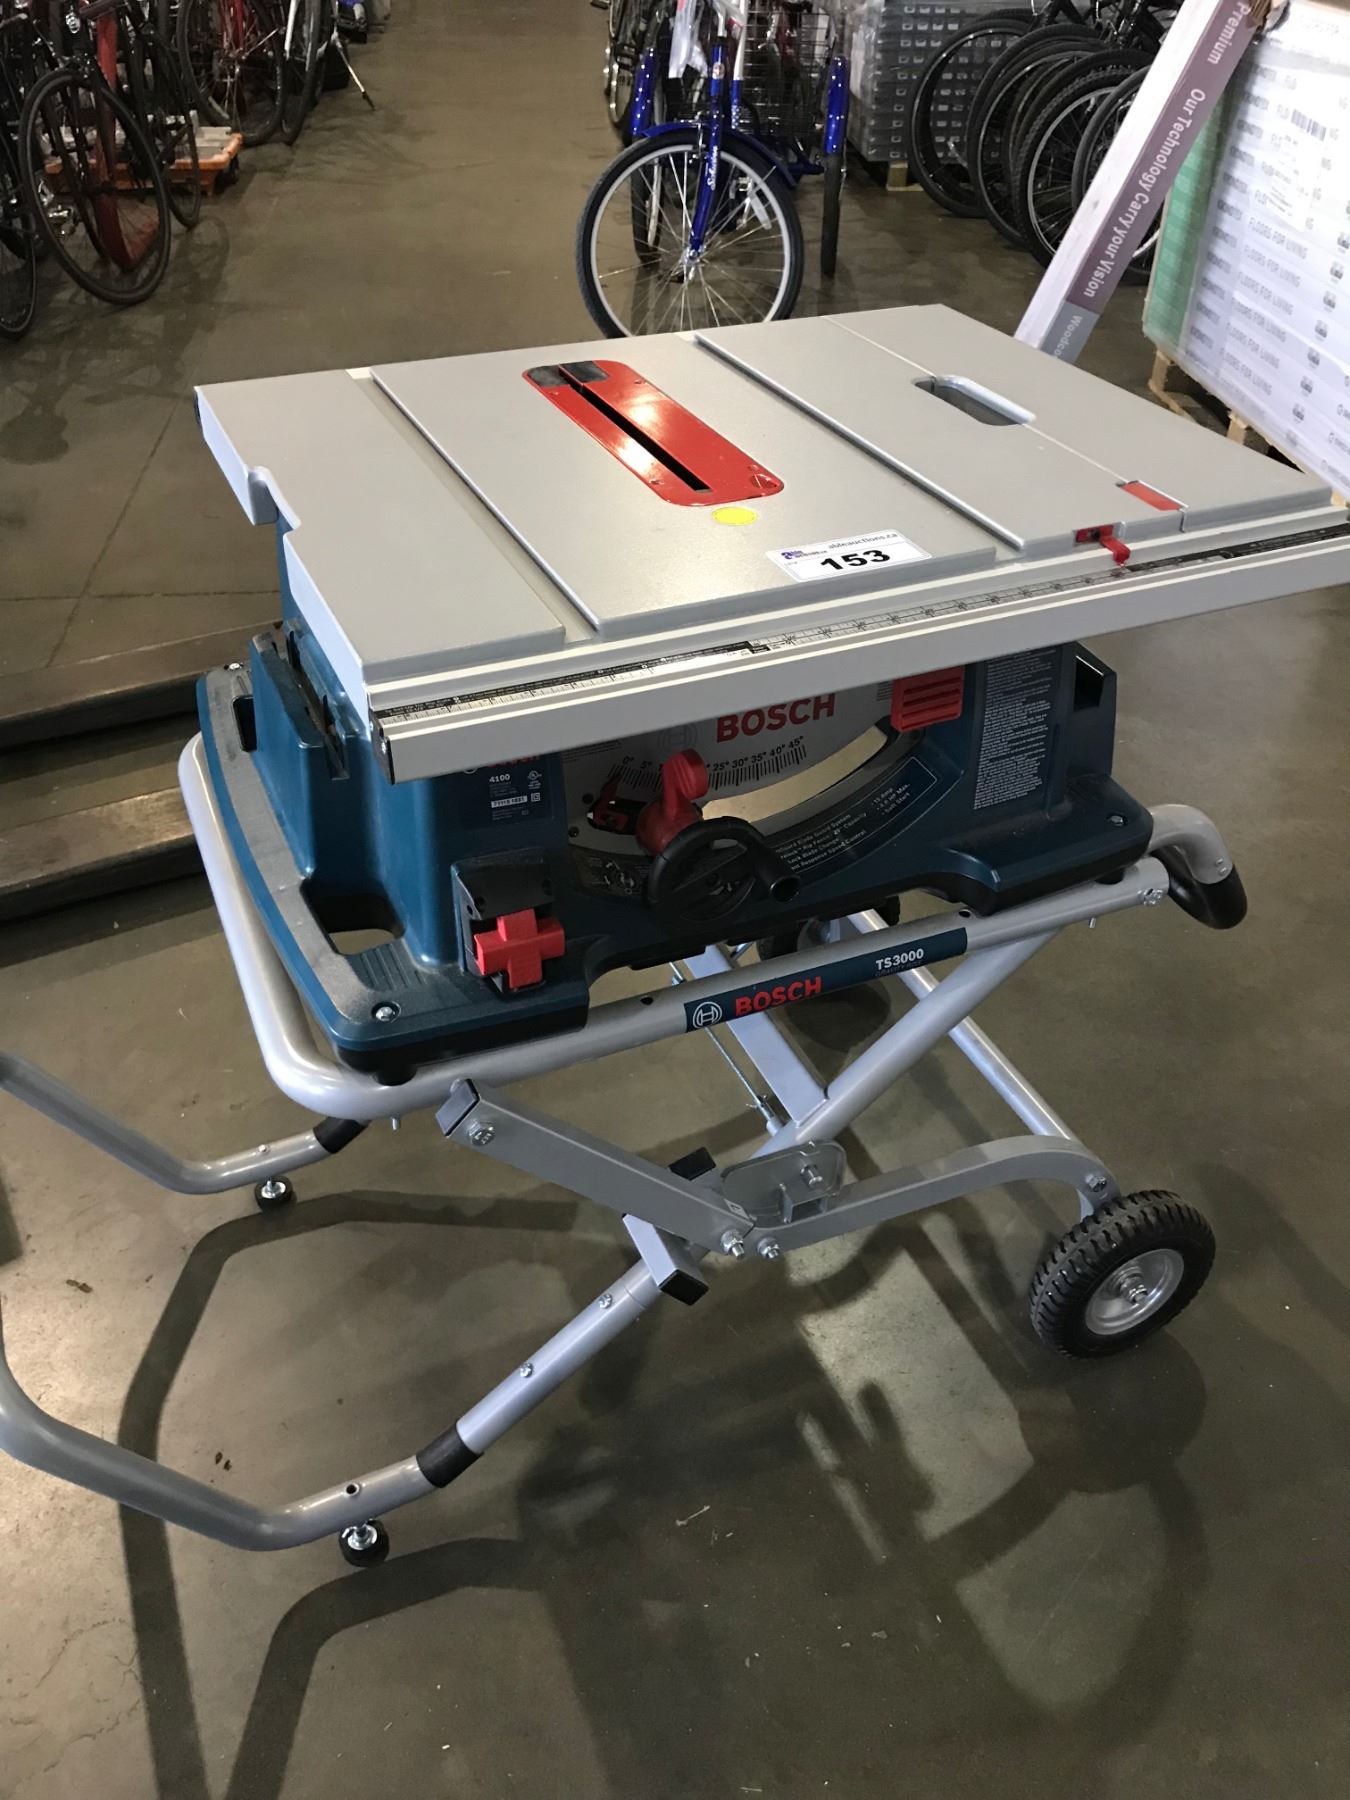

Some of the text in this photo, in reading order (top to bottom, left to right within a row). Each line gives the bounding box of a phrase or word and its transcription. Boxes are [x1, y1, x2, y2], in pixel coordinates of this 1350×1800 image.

[1083, 2, 1251, 297] Premium Our Technology Carry your Vision
[828, 533, 898, 549] ableauctions.ca
[821, 549, 890, 570] 153
[716, 692, 836, 743] BOSCH
[713, 761, 730, 772] 25°
[731, 757, 749, 769] 30°
[751, 751, 766, 764] 35°
[769, 743, 786, 757] 40°
[788, 736, 804, 749] 45°
[489, 773, 511, 783] 4100
[875, 948, 924, 971] TS3000
[735, 976, 822, 1016] BOSCH
